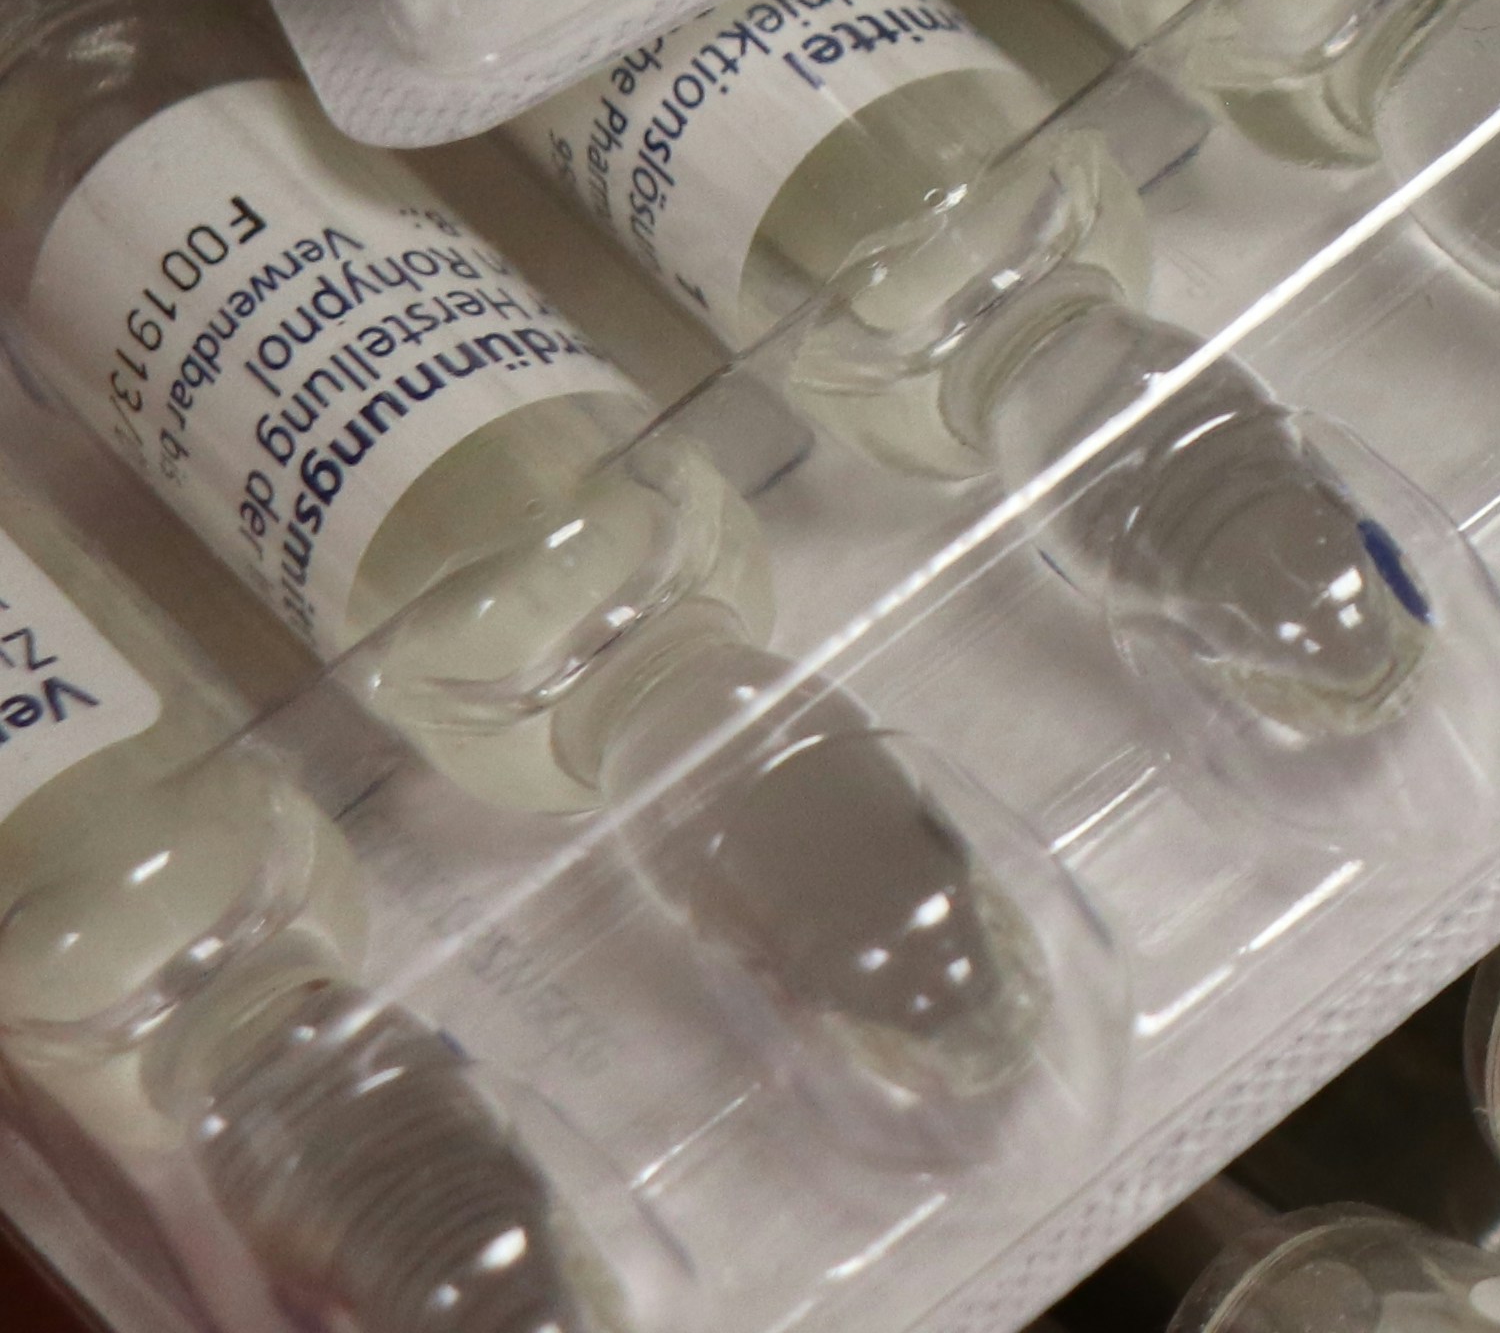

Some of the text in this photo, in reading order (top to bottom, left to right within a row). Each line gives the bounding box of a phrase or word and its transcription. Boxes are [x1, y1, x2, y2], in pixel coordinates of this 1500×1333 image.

[167, 226, 365, 426] Verwendbar
[244, 243, 480, 397] Rohypnol
[254, 287, 535, 467] Herstellung
